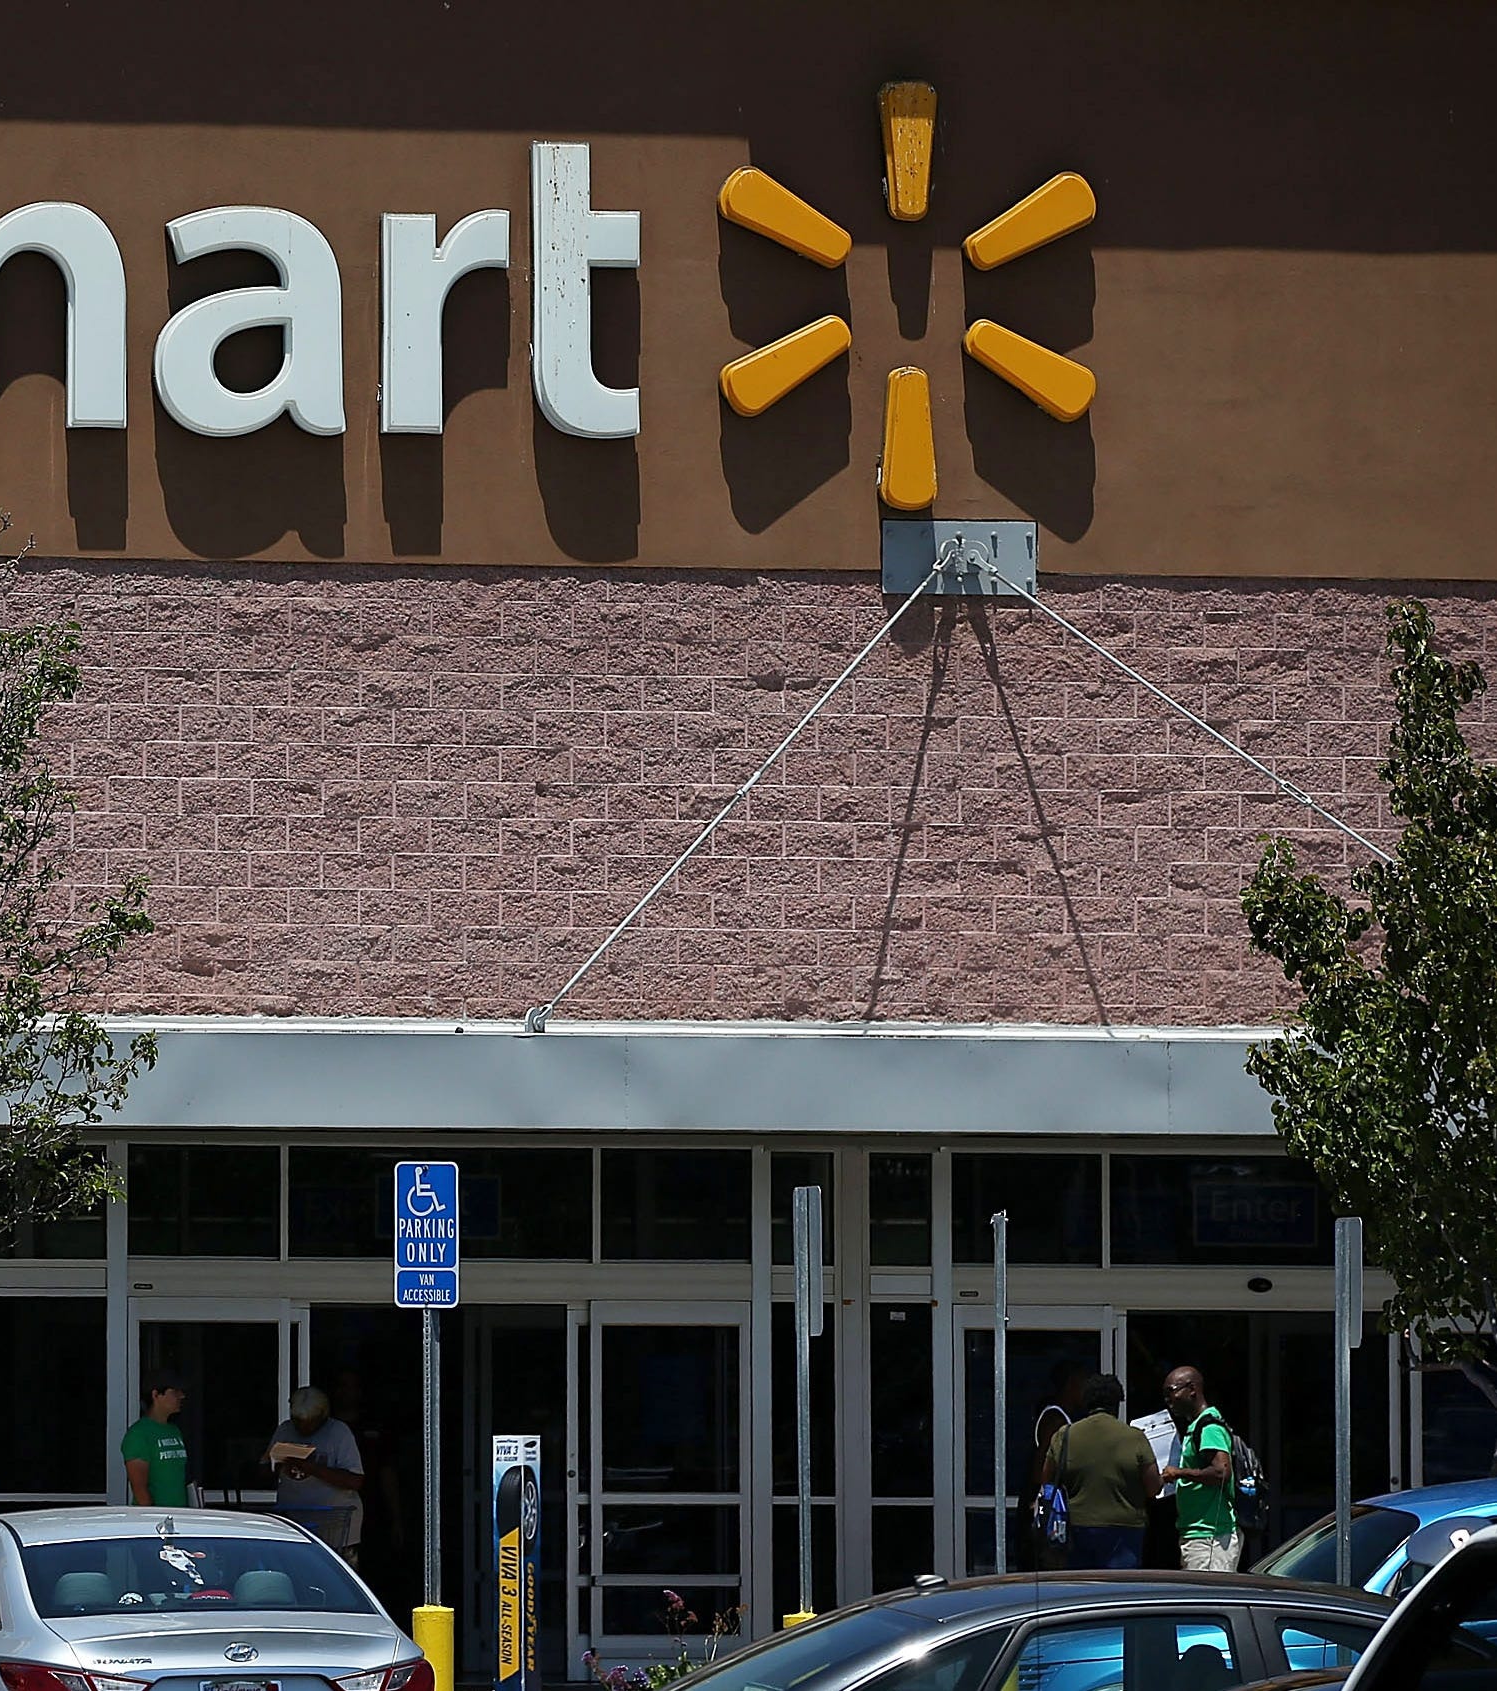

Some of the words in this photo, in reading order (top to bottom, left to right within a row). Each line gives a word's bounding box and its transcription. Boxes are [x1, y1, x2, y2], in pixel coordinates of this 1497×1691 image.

[399, 1218, 454, 1239] PARKING
[406, 1242, 446, 1262] ONLY
[419, 1274, 435, 1286] VAN
[403, 1289, 451, 1302] ACCESSIBLE
[501, 1546, 517, 1580] VIVA
[501, 1586, 517, 1597] 3
[526, 1562, 538, 1672] GOODYEAR
[501, 1602, 513, 1665] ALL-SEASON
